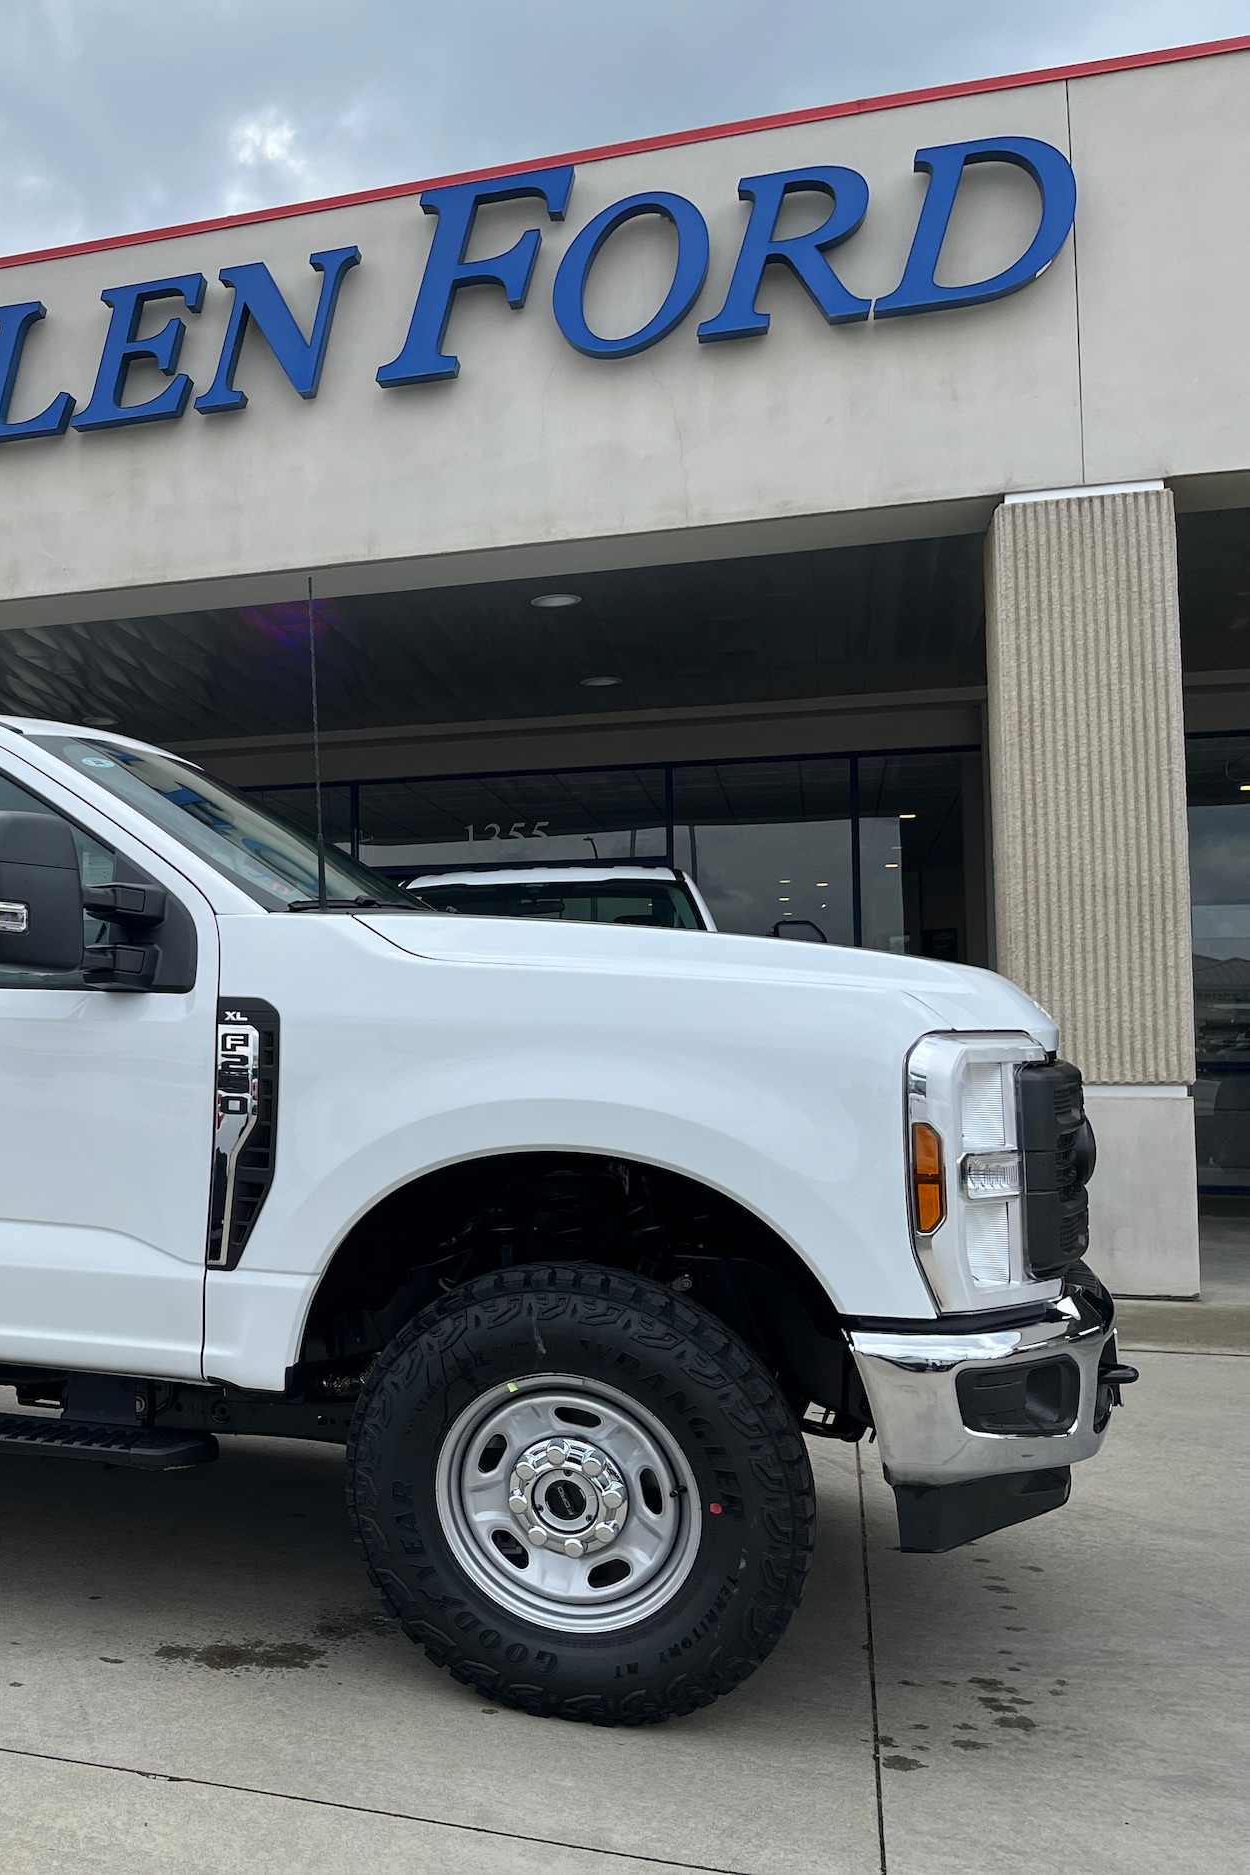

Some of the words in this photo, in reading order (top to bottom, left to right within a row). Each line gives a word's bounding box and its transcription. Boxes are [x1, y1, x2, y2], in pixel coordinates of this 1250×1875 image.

[376, 136, 1077, 388] FORD
[464, 821, 549, 857] 1355
[225, 1011, 248, 1021] XL
[579, 1337, 746, 1521] WRANGLER
[557, 1486, 574, 1515] FORD
[391, 1479, 560, 1676] GOODYEAR
[658, 1573, 739, 1666] TERRITORY
[613, 1661, 640, 1679] RT
